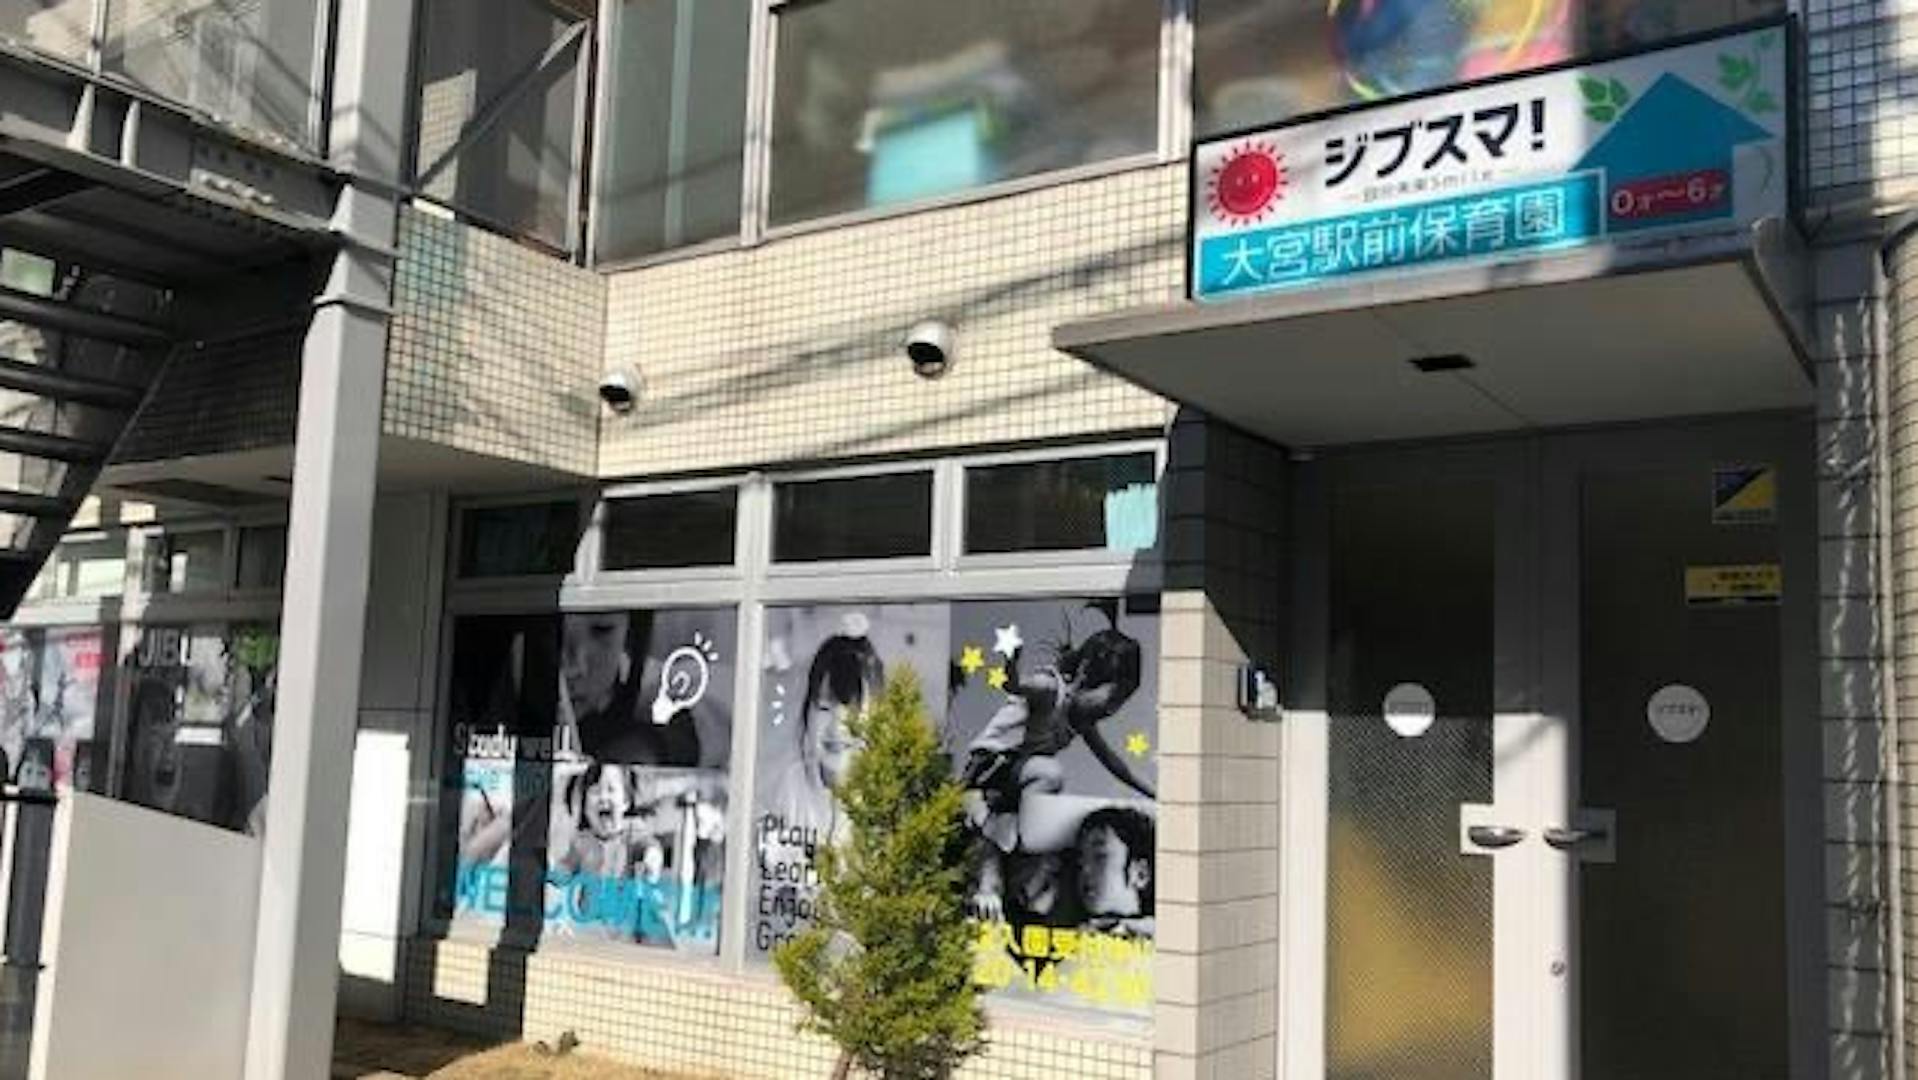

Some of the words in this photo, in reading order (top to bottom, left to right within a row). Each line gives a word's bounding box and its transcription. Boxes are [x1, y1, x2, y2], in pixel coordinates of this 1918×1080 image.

[1222, 187, 1565, 286] 大宮駅前保育園
